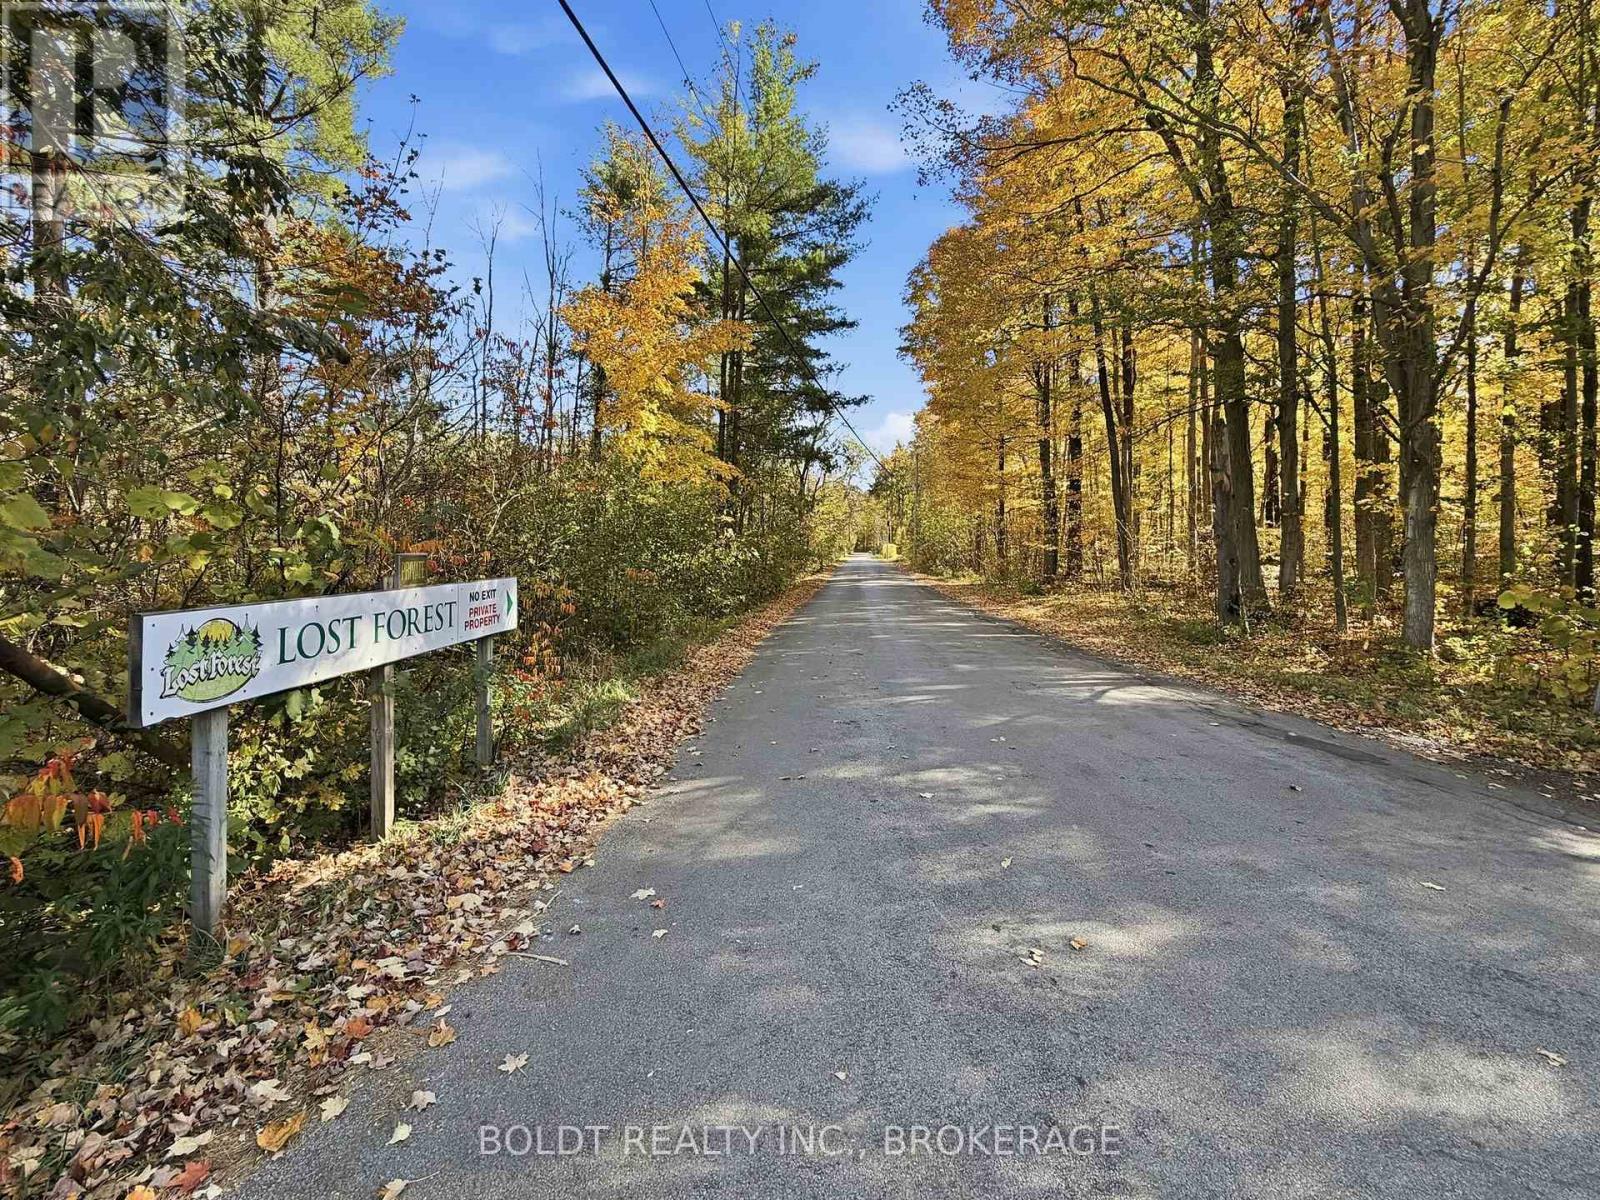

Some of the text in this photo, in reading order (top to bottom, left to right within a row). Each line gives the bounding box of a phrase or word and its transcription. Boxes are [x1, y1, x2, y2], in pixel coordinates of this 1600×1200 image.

[469, 588, 497, 603] NO EXIT
[277, 601, 457, 665] LOST FOREST
[464, 603, 501, 631] PRIVATE PROPERTY
[160, 655, 209, 699] Lost
